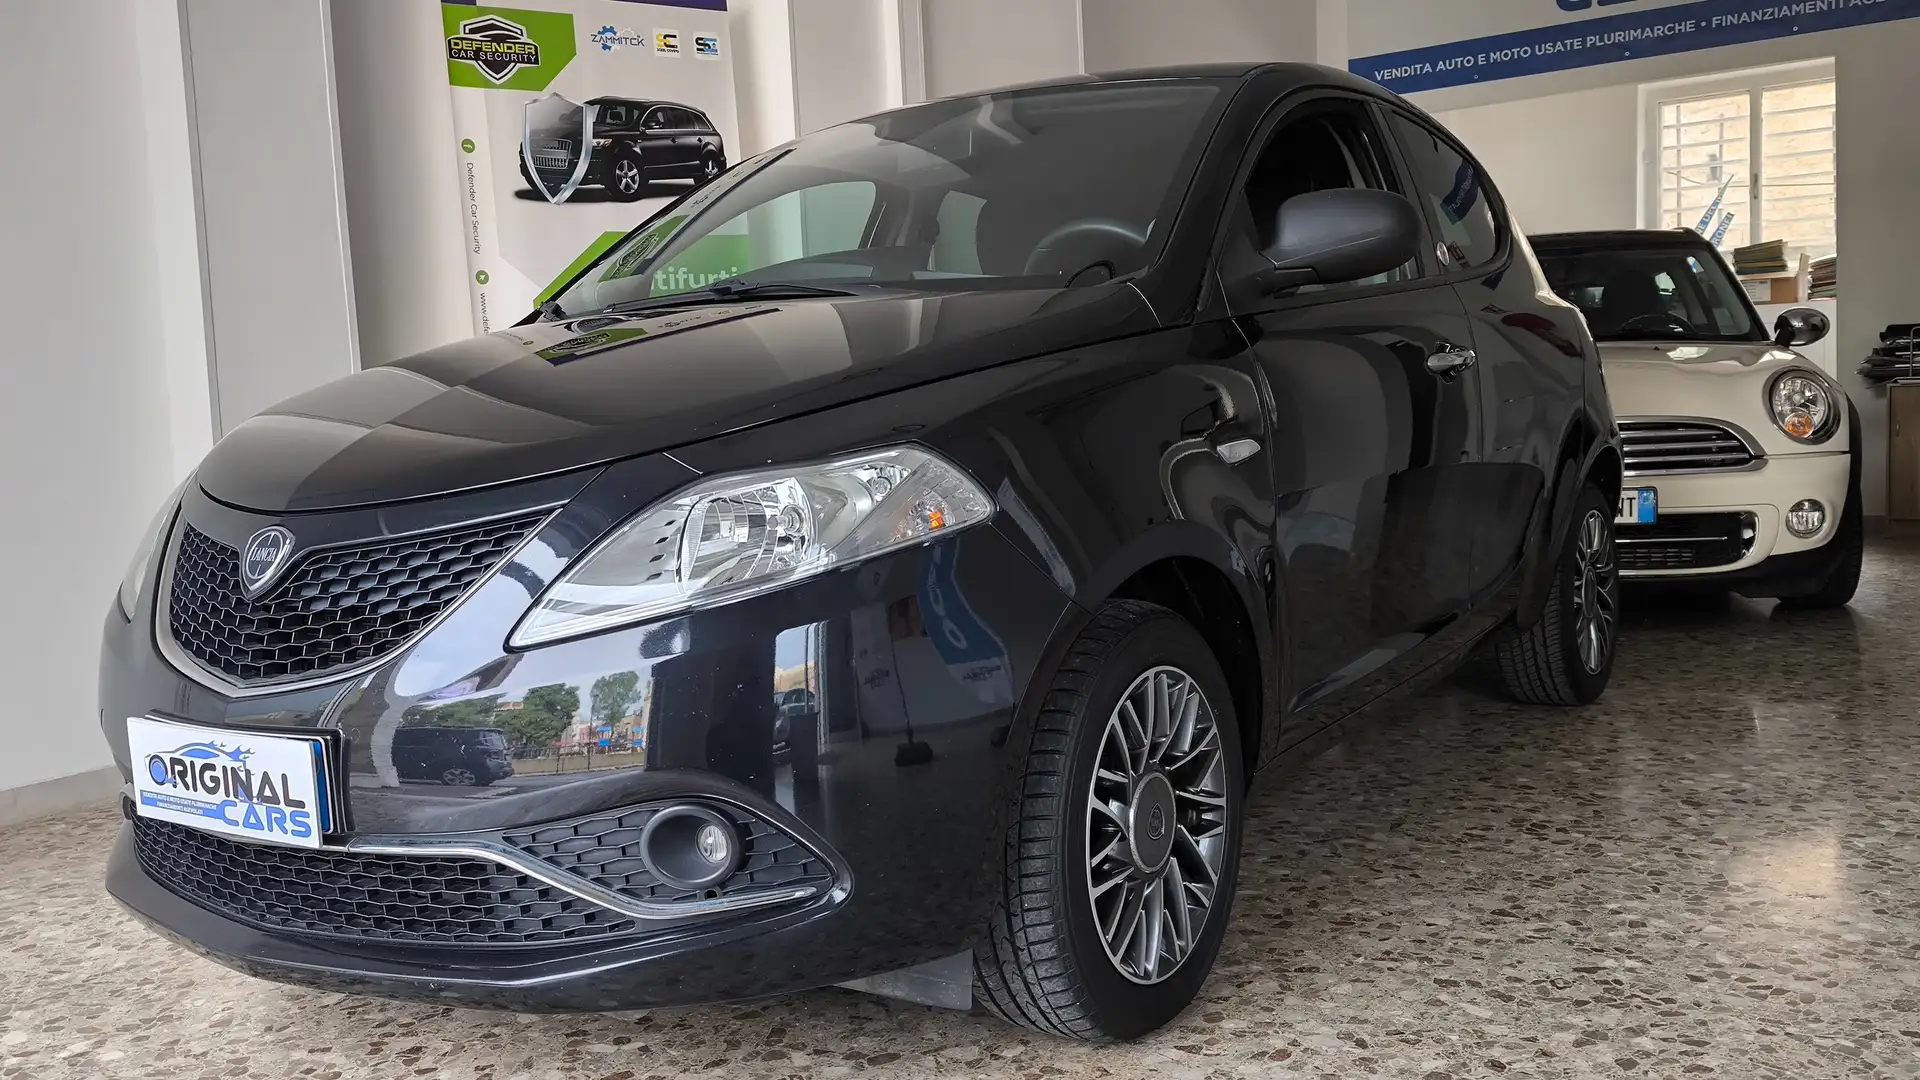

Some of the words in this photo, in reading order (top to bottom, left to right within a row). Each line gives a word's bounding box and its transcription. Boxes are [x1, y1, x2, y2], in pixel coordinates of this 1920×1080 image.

[450, 39, 536, 55] DEFENDER
[451, 49, 475, 59] CAR
[479, 52, 537, 63] SECURITY
[1374, 61, 1432, 81] VENDITA
[1436, 56, 1475, 72] AUTO
[1478, 53, 1486, 65] E
[1490, 46, 1532, 63] MOTO
[1535, 38, 1583, 55] USATE
[1586, 20, 1696, 48] PLURIMARCHE
[1712, 0, 1843, 28] FINANZIAMENTI
[466, 162, 477, 202] Defender
[470, 204, 478, 218] Car
[472, 220, 481, 255] Security
[148, 754, 306, 810] ORIGINAL
[220, 799, 312, 839] CARS
